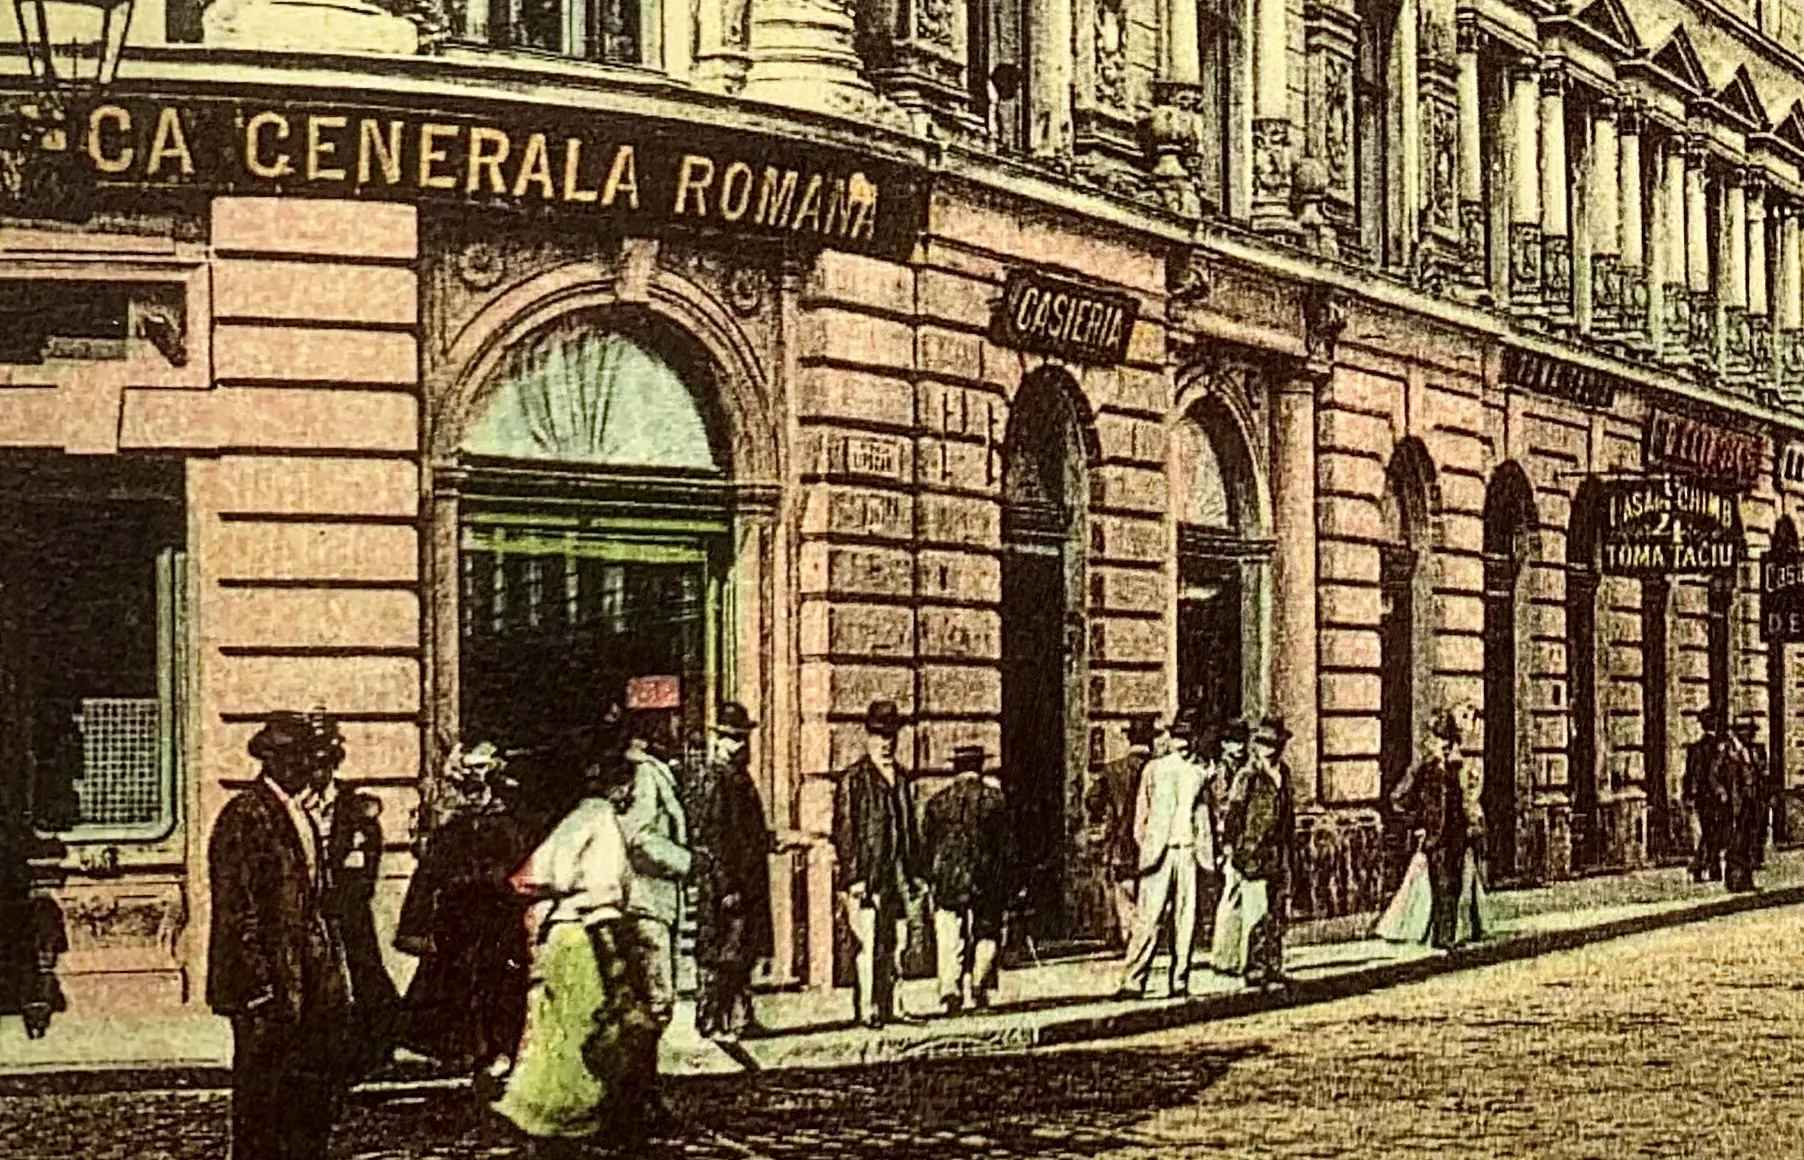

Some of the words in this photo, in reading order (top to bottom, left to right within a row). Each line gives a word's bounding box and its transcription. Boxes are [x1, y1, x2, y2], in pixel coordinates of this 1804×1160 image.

[245, 111, 640, 209] GENERALA
[1016, 286, 1123, 351] CASIERIA
[1605, 543, 1664, 569] TOMA
